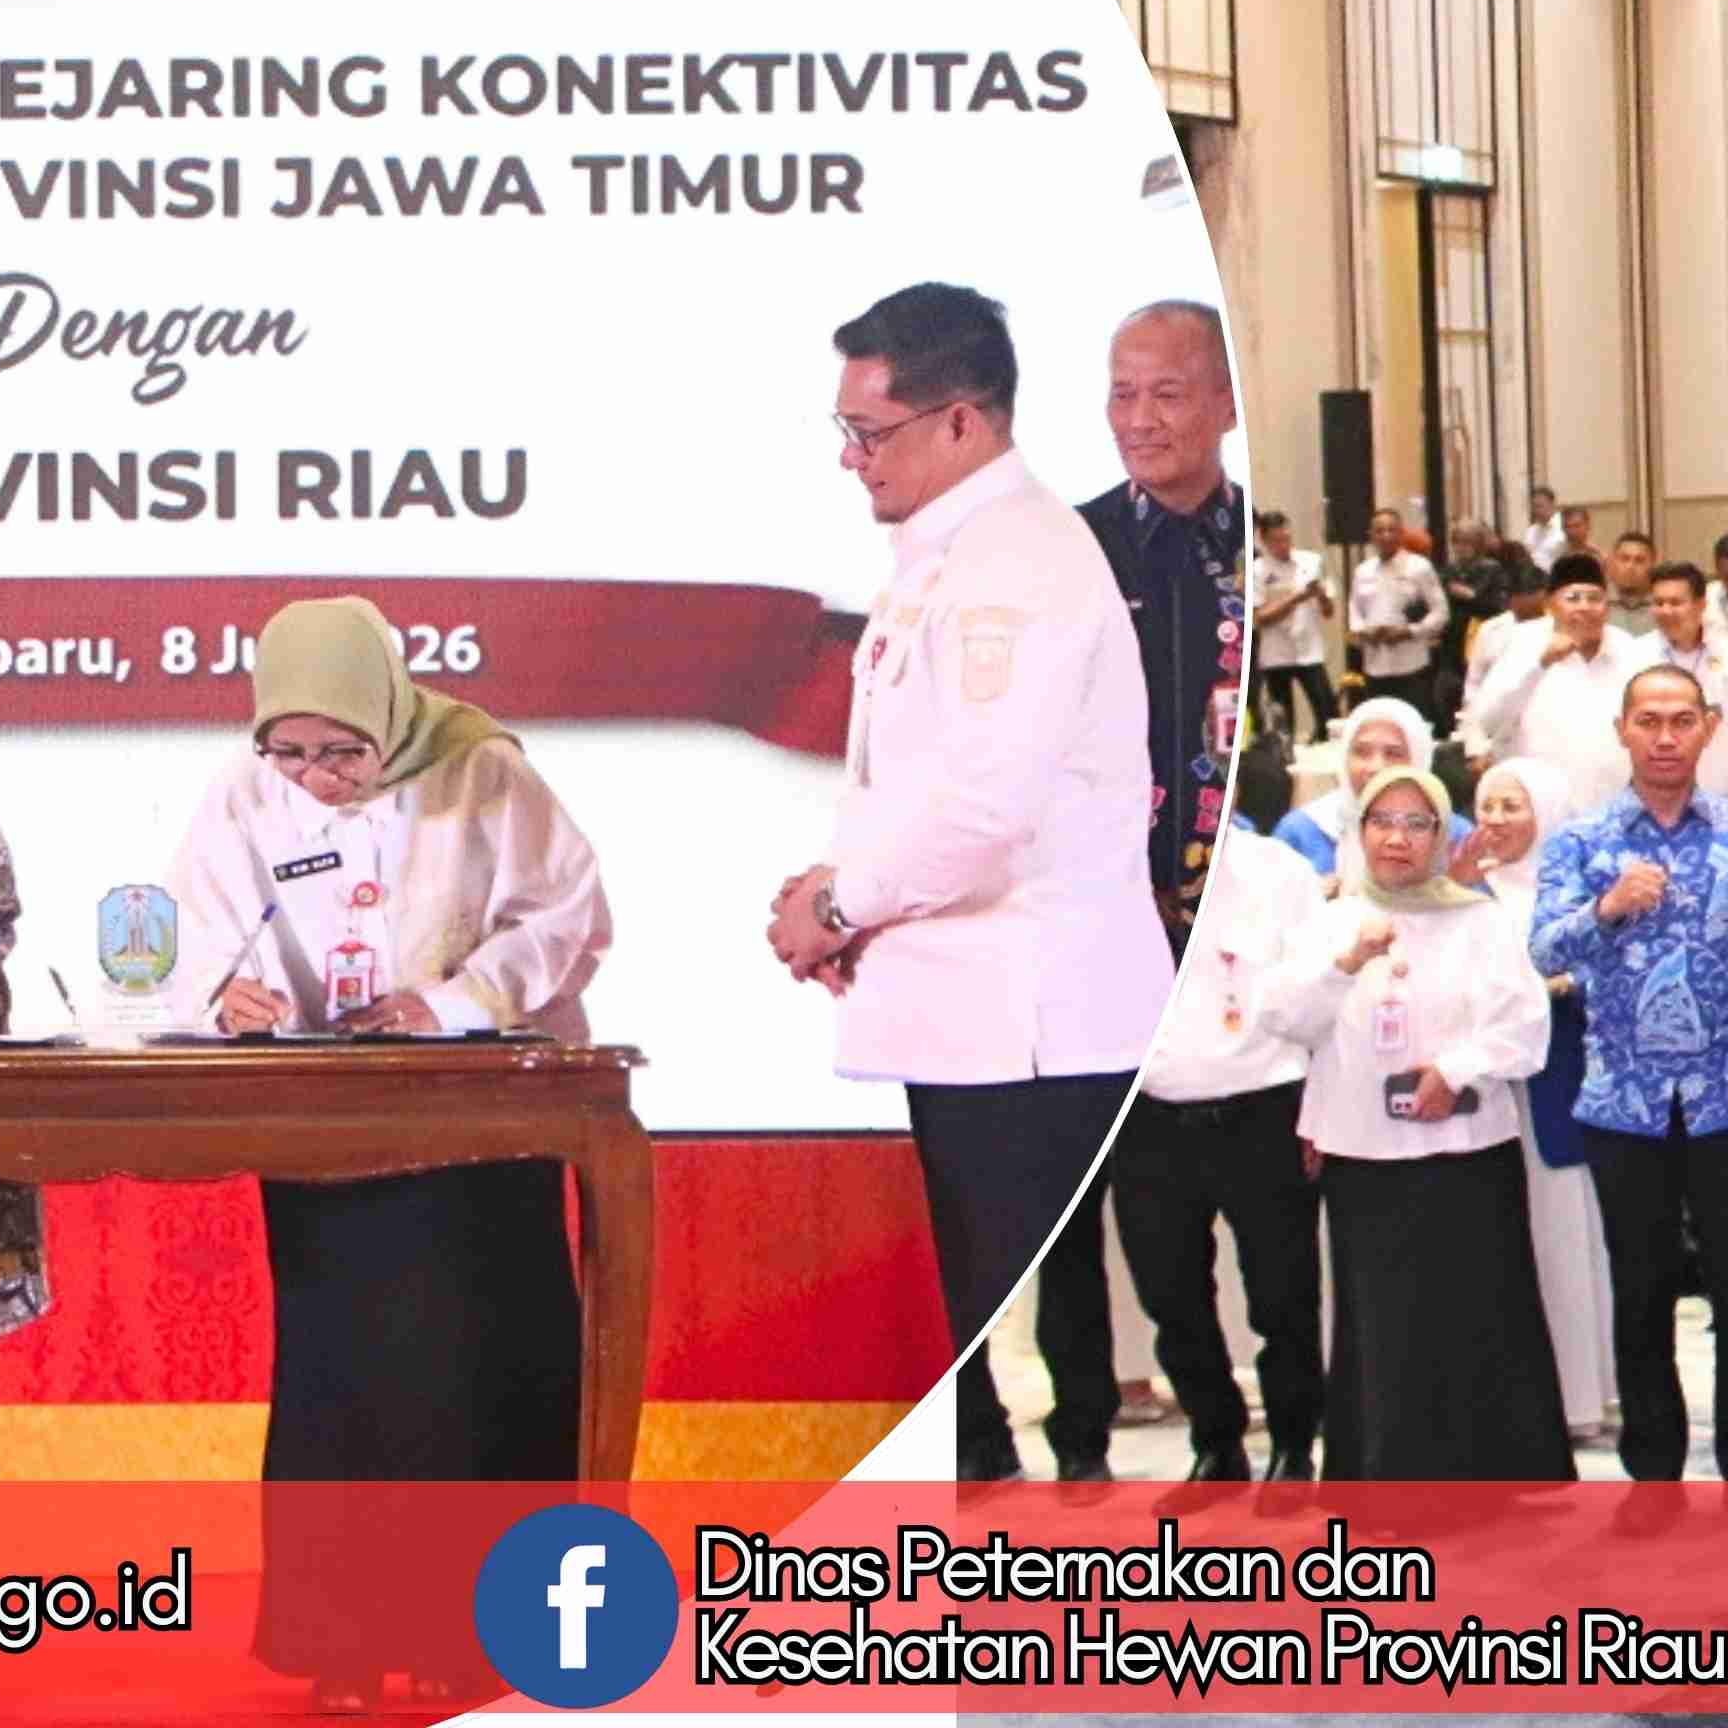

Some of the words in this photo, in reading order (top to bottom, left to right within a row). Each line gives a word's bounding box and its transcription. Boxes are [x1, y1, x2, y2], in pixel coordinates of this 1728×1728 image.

[421, 49, 1088, 117] KONEKTIVITAS
[270, 155, 546, 219] JAWA
[570, 153, 865, 216] TIMUR
[277, 448, 527, 520] RIAU
[161, 626, 196, 674] 8
